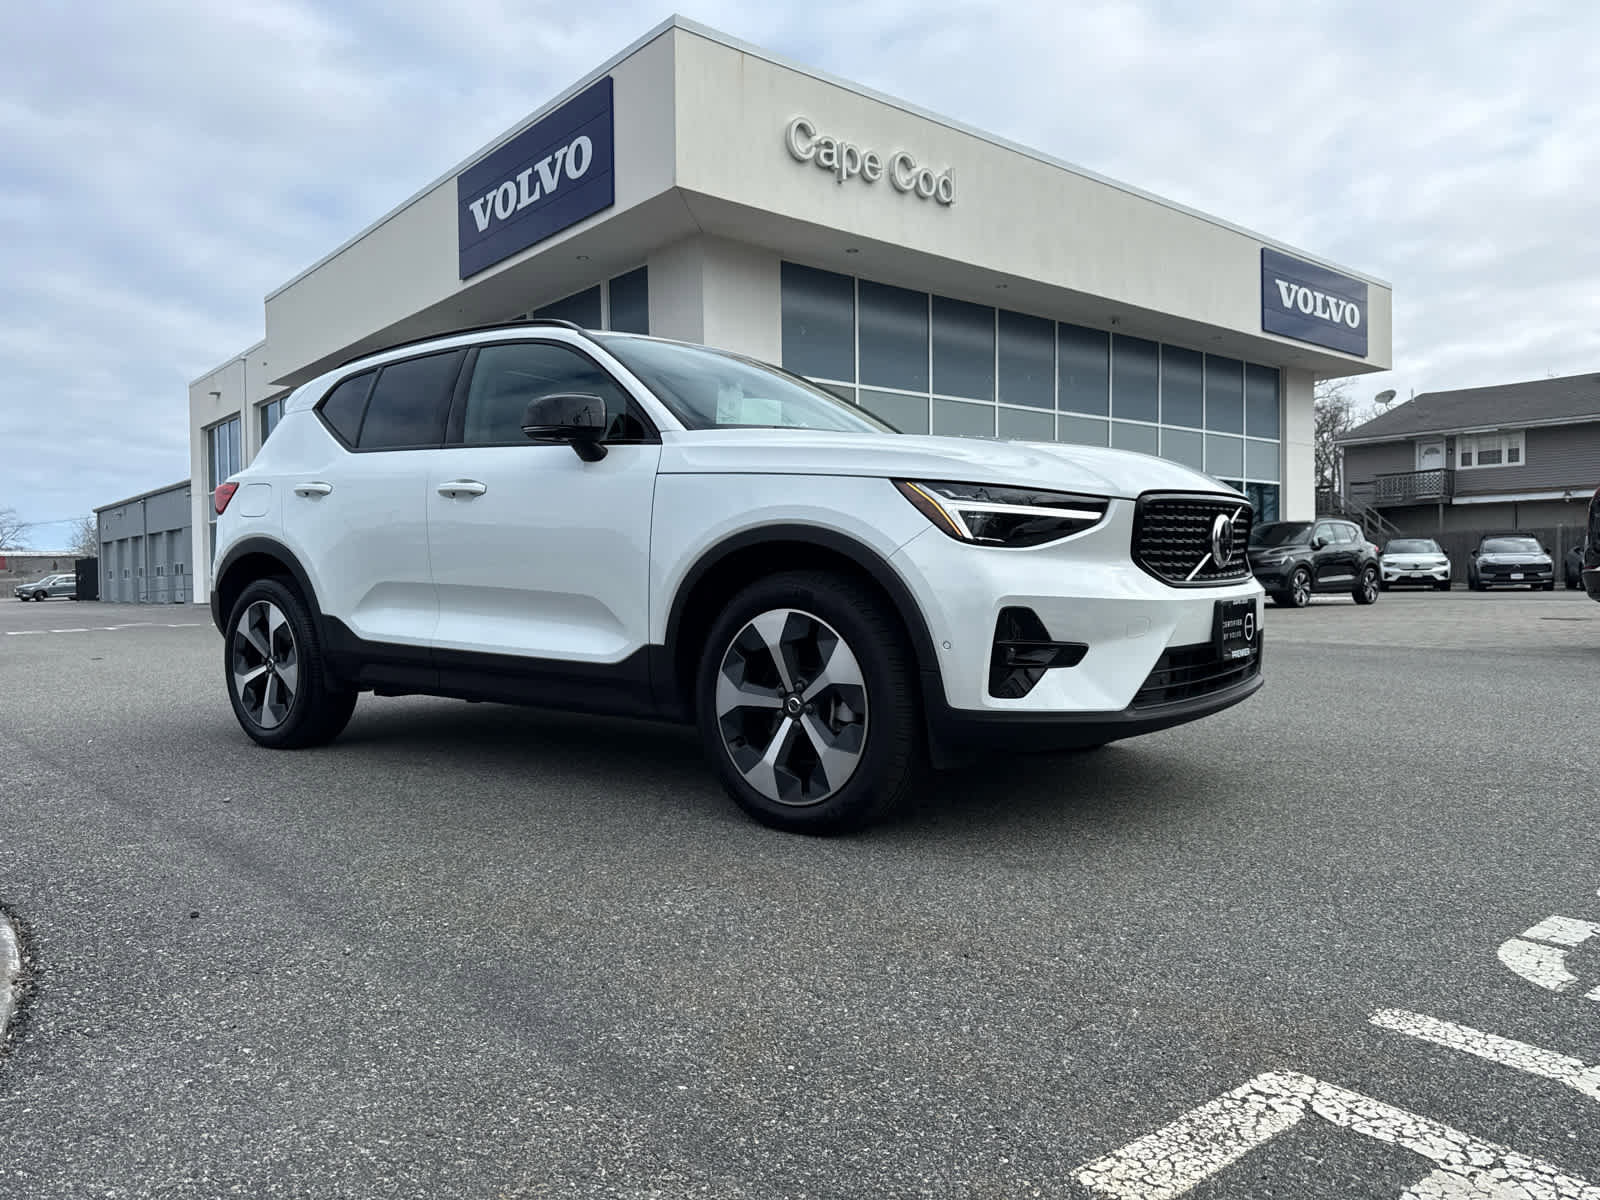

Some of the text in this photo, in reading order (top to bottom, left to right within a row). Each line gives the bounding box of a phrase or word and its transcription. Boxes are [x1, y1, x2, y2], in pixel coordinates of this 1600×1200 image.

[468, 135, 593, 233] VOLVO
[785, 116, 957, 206] Cape Cod
[1274, 278, 1361, 329] VOLVO
